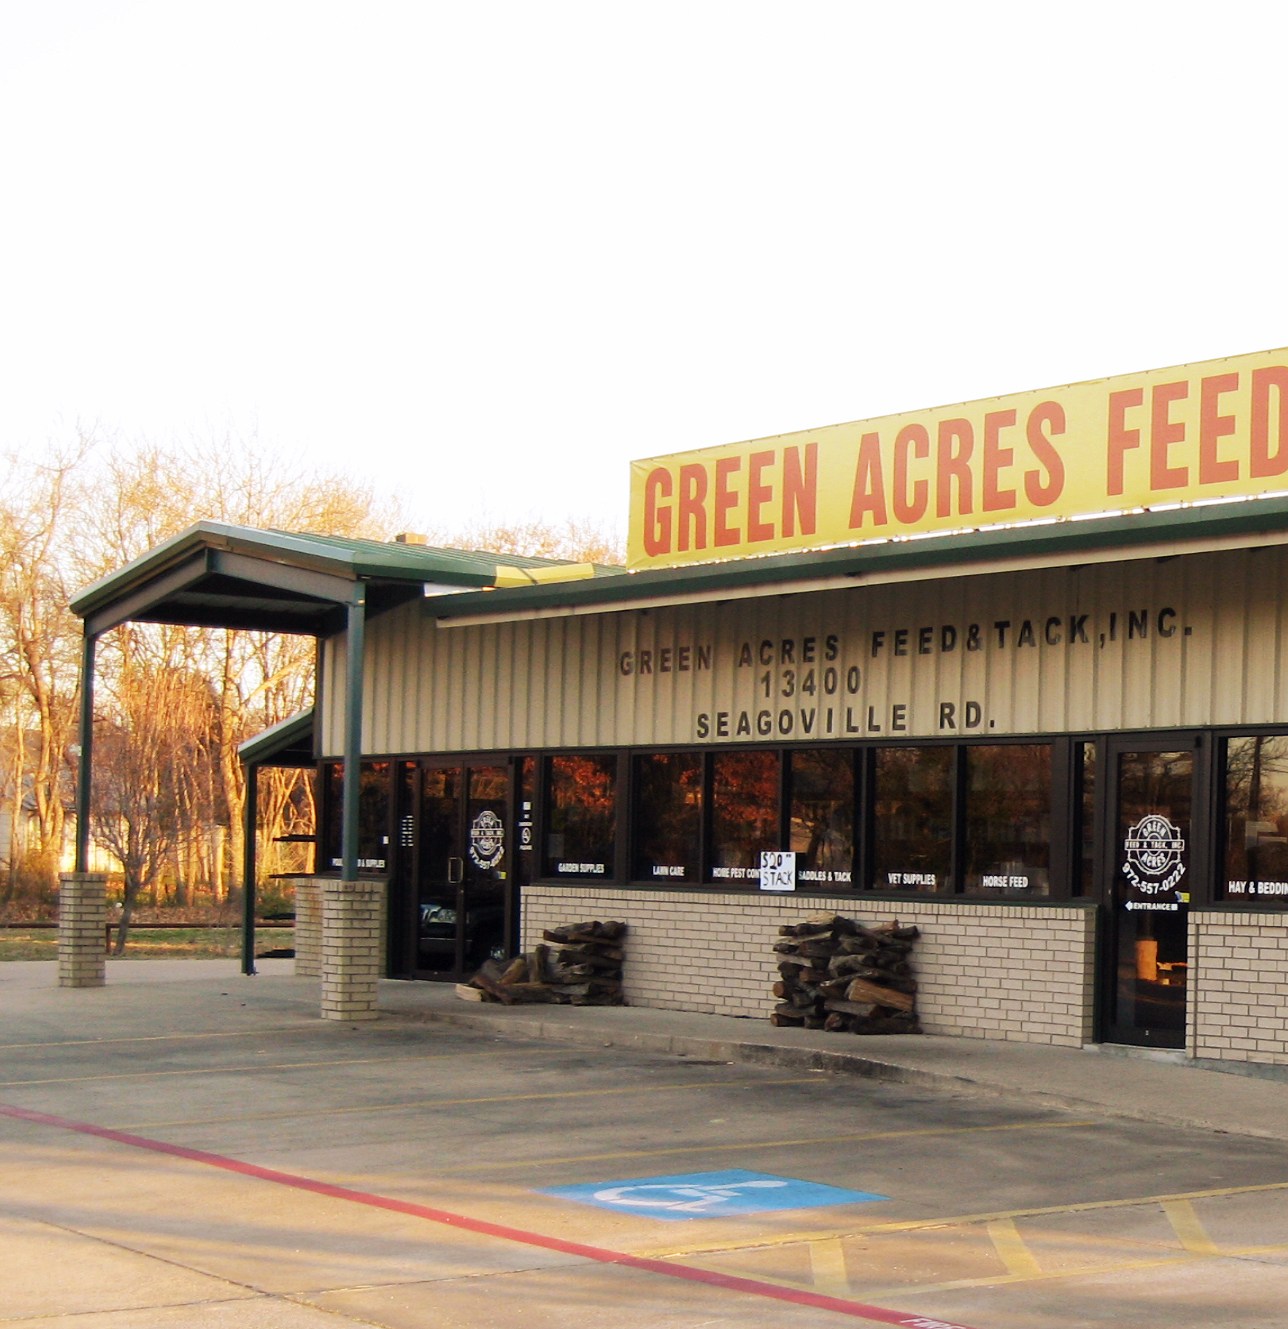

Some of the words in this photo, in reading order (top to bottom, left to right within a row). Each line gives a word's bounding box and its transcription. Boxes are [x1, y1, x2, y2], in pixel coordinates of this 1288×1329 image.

[643, 442, 818, 558] GREEN
[848, 400, 1066, 530] ACRES
[620, 646, 711, 676] GREEN
[738, 634, 839, 668] ACRES
[761, 666, 861, 698] 13400
[697, 704, 907, 738] SEAGOVILLE
[939, 701, 995, 730] RD.
[1142, 821, 1167, 837] GREEN
[1141, 852, 1166, 868] ACRES
[558, 863, 579, 872] GARDEN
[580, 864, 604, 873] SUPPLIES
[652, 866, 668, 875] LAWN
[670, 866, 684, 876] CARE
[730, 868, 745, 878] PEST
[763, 871, 793, 886] STACK
[798, 870, 826, 880] SADDLES
[834, 871, 851, 882] TACK
[888, 873, 902, 883] VET
[903, 873, 936, 885] SUPPLIES
[983, 876, 1007, 887] HORSE
[1009, 876, 1029, 887] FEED
[1122, 862, 1186, 894] 972-557-0222
[1228, 880, 1247, 893] HAY
[1248, 881, 1256, 893] &
[1133, 902, 1171, 911] ENTRANCE
